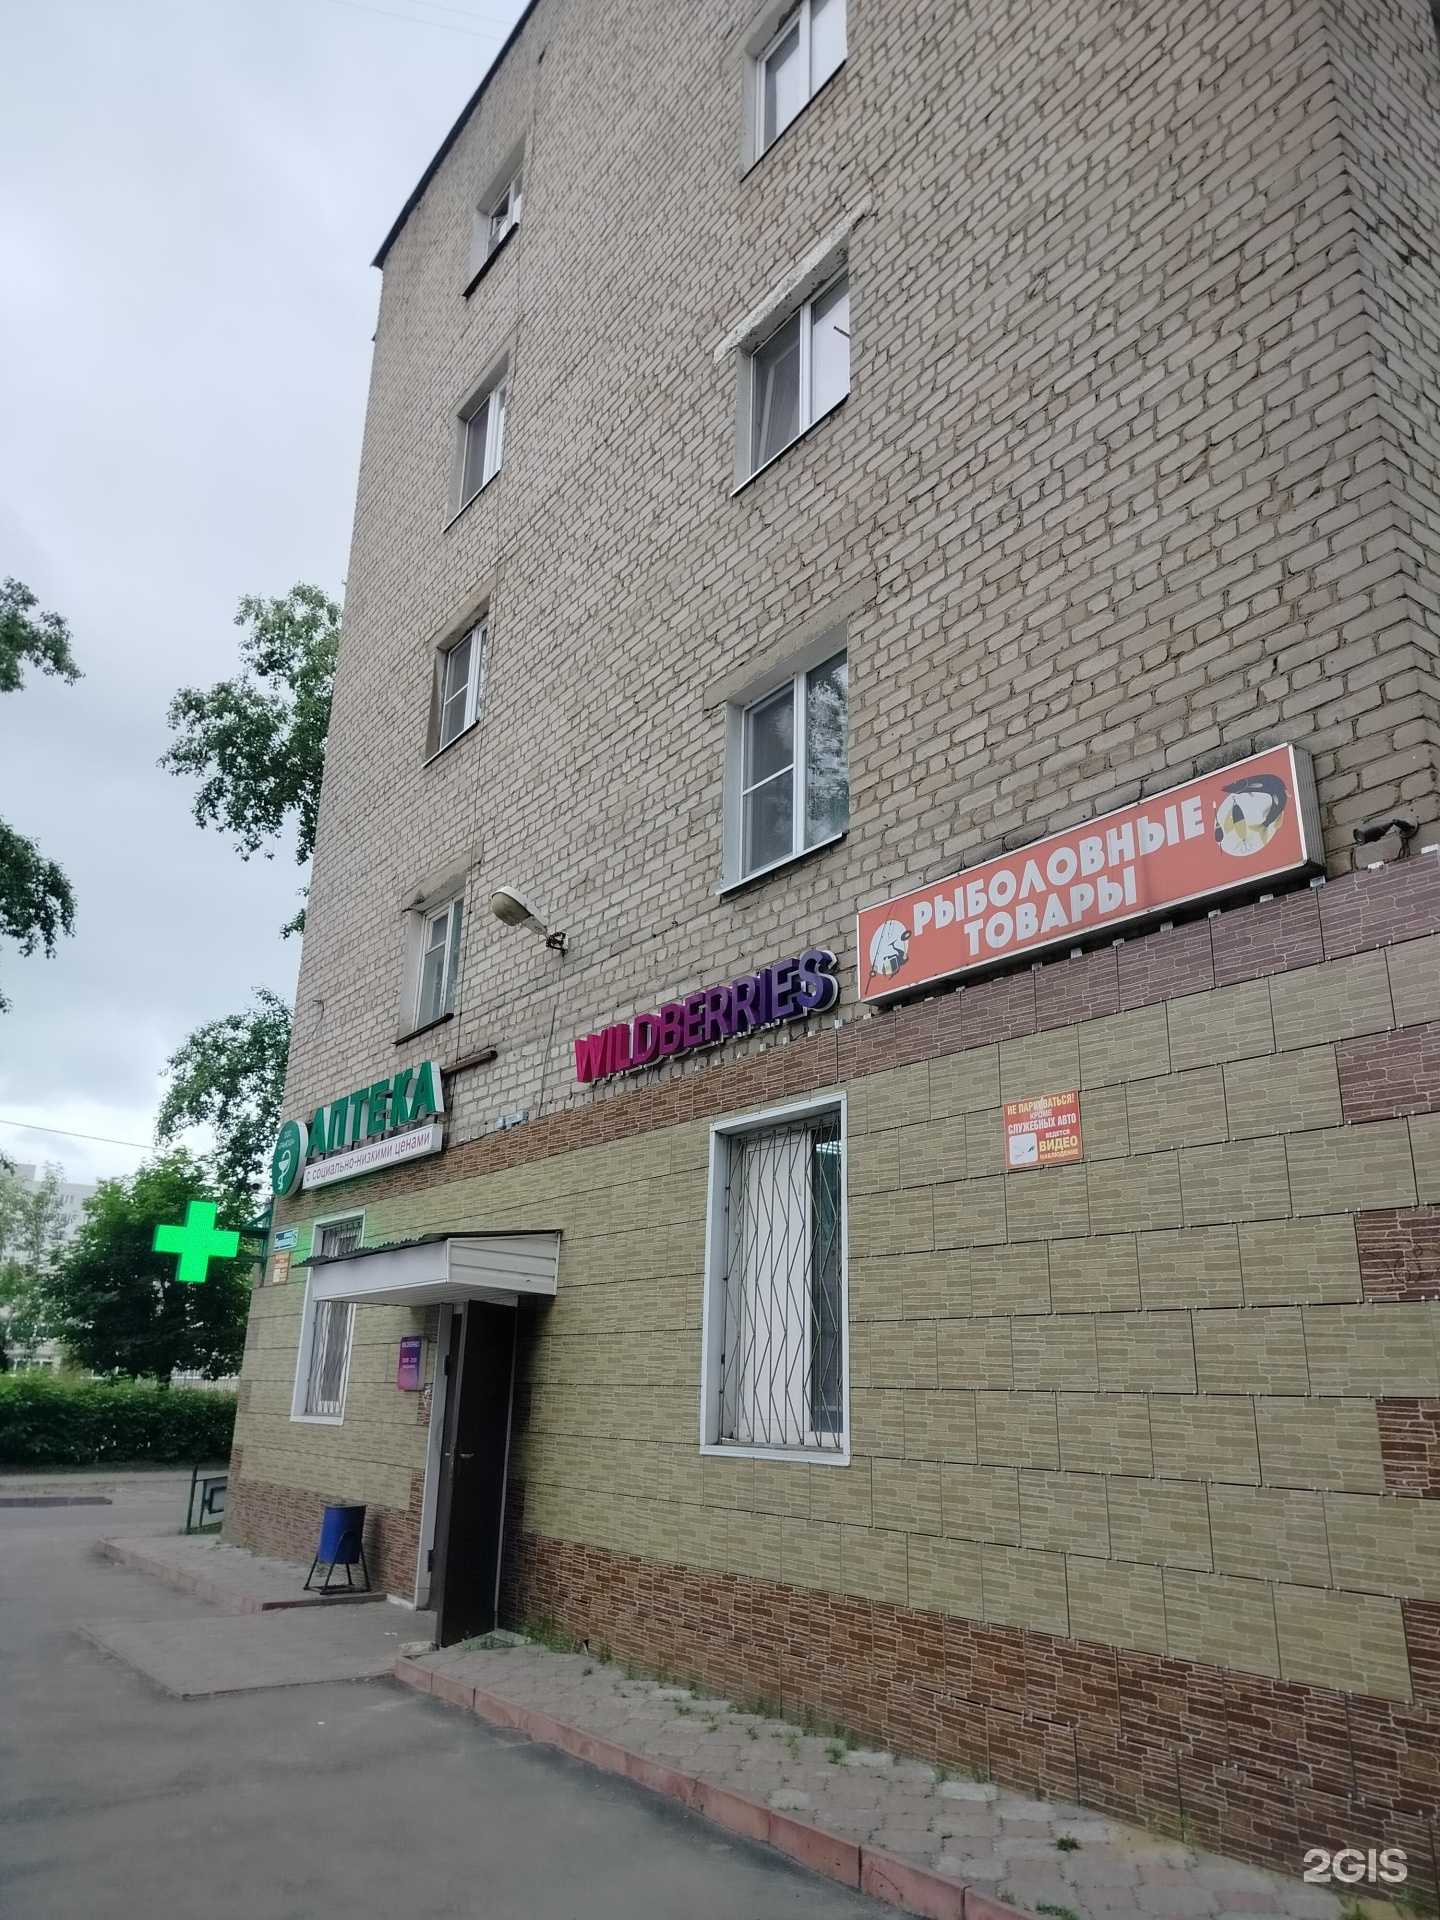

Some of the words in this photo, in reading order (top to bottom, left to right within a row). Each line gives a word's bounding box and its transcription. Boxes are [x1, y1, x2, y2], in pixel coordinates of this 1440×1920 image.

[913, 794, 1205, 936] РЫБОЛОВНЫЕ
[963, 866, 1137, 956] ТОВАРЫ
[575, 950, 838, 1083] WILDBERRIES
[305, 1061, 441, 1157] АПТЕКА
[1007, 1104, 1017, 1115] НЕ
[1008, 1116, 1056, 1135] СЛУЖЕБНЫХ
[1057, 1112, 1077, 1126] АВТО
[1029, 1109, 1053, 1119] КРОМЕ
[312, 1146, 393, 1179] социально-низкими
[394, 1132, 431, 1155] ценами
[1039, 1135, 1078, 1152] ВИДЕО
